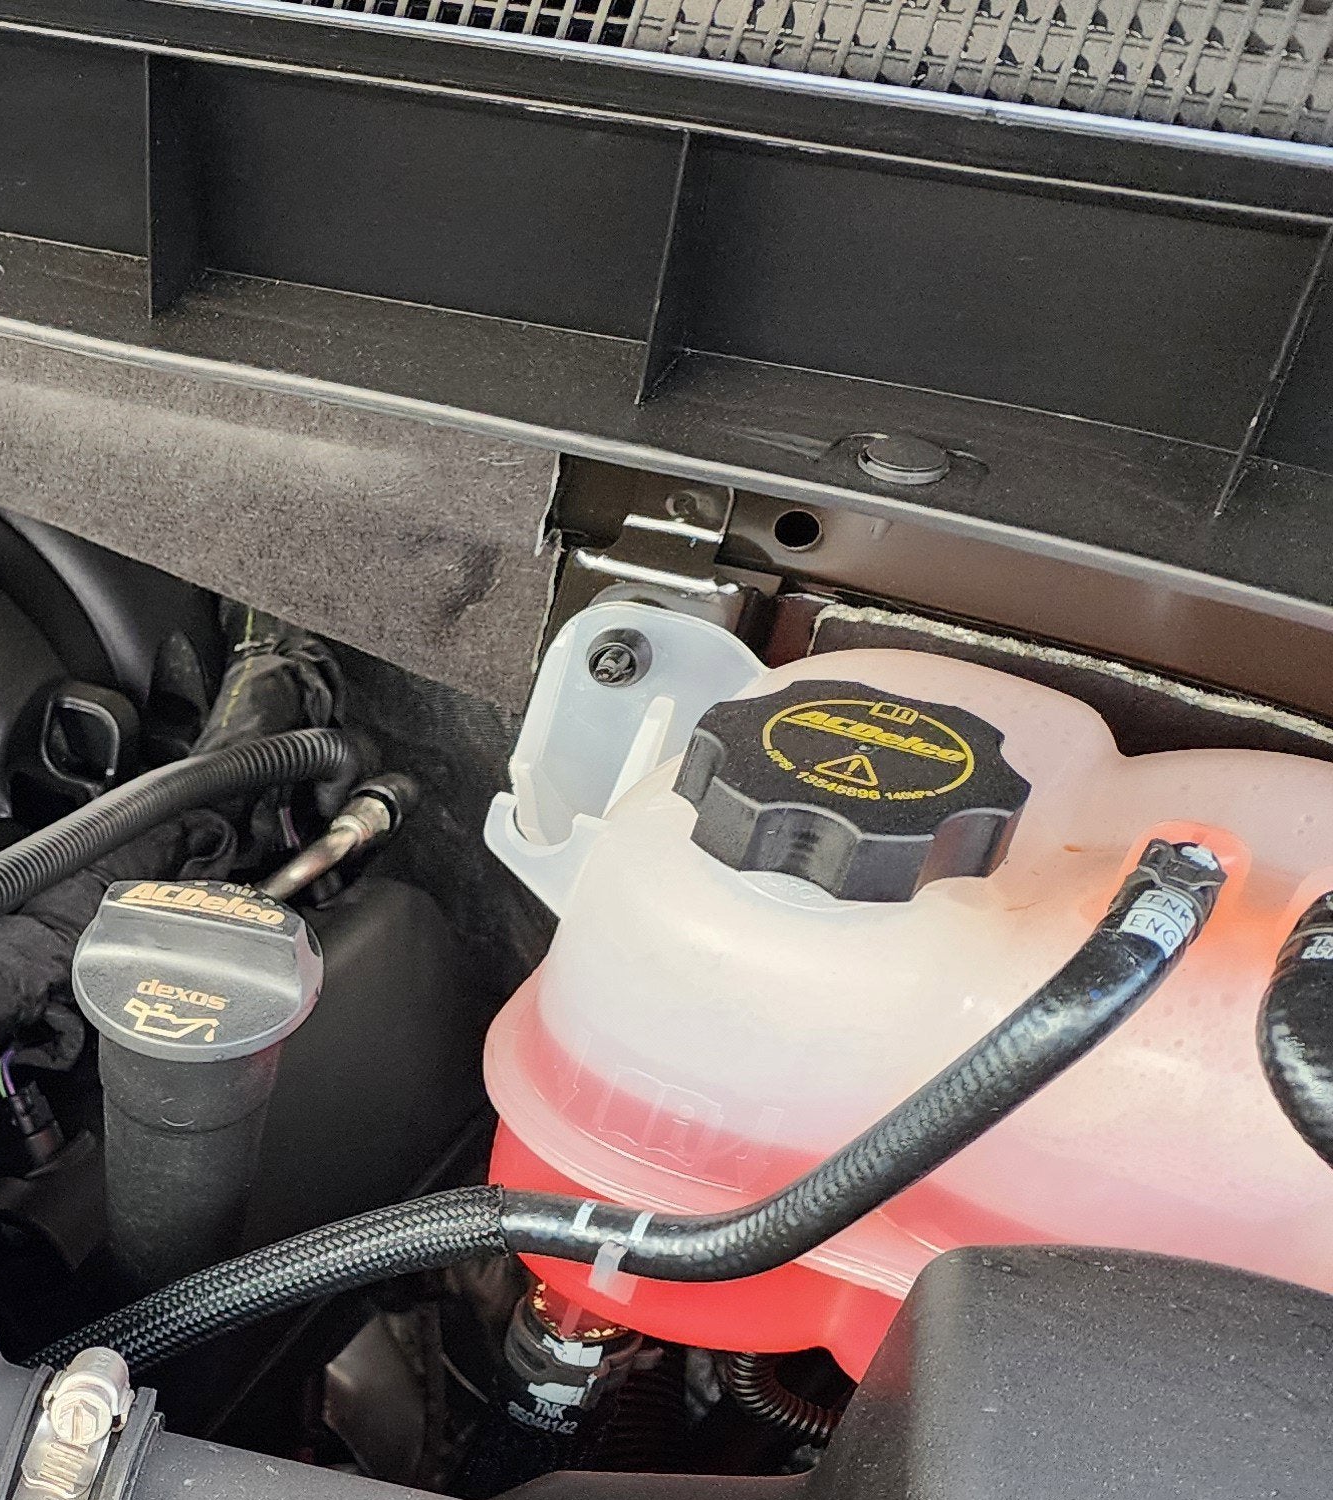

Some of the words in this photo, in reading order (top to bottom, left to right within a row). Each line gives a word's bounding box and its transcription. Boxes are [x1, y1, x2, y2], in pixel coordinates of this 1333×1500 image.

[792, 710, 967, 763] ACDelco
[122, 883, 286, 925] ACDelco
[1128, 913, 1179, 947] ENG
[136, 979, 229, 1010] dexos
[534, 1397, 567, 1420] TNK
